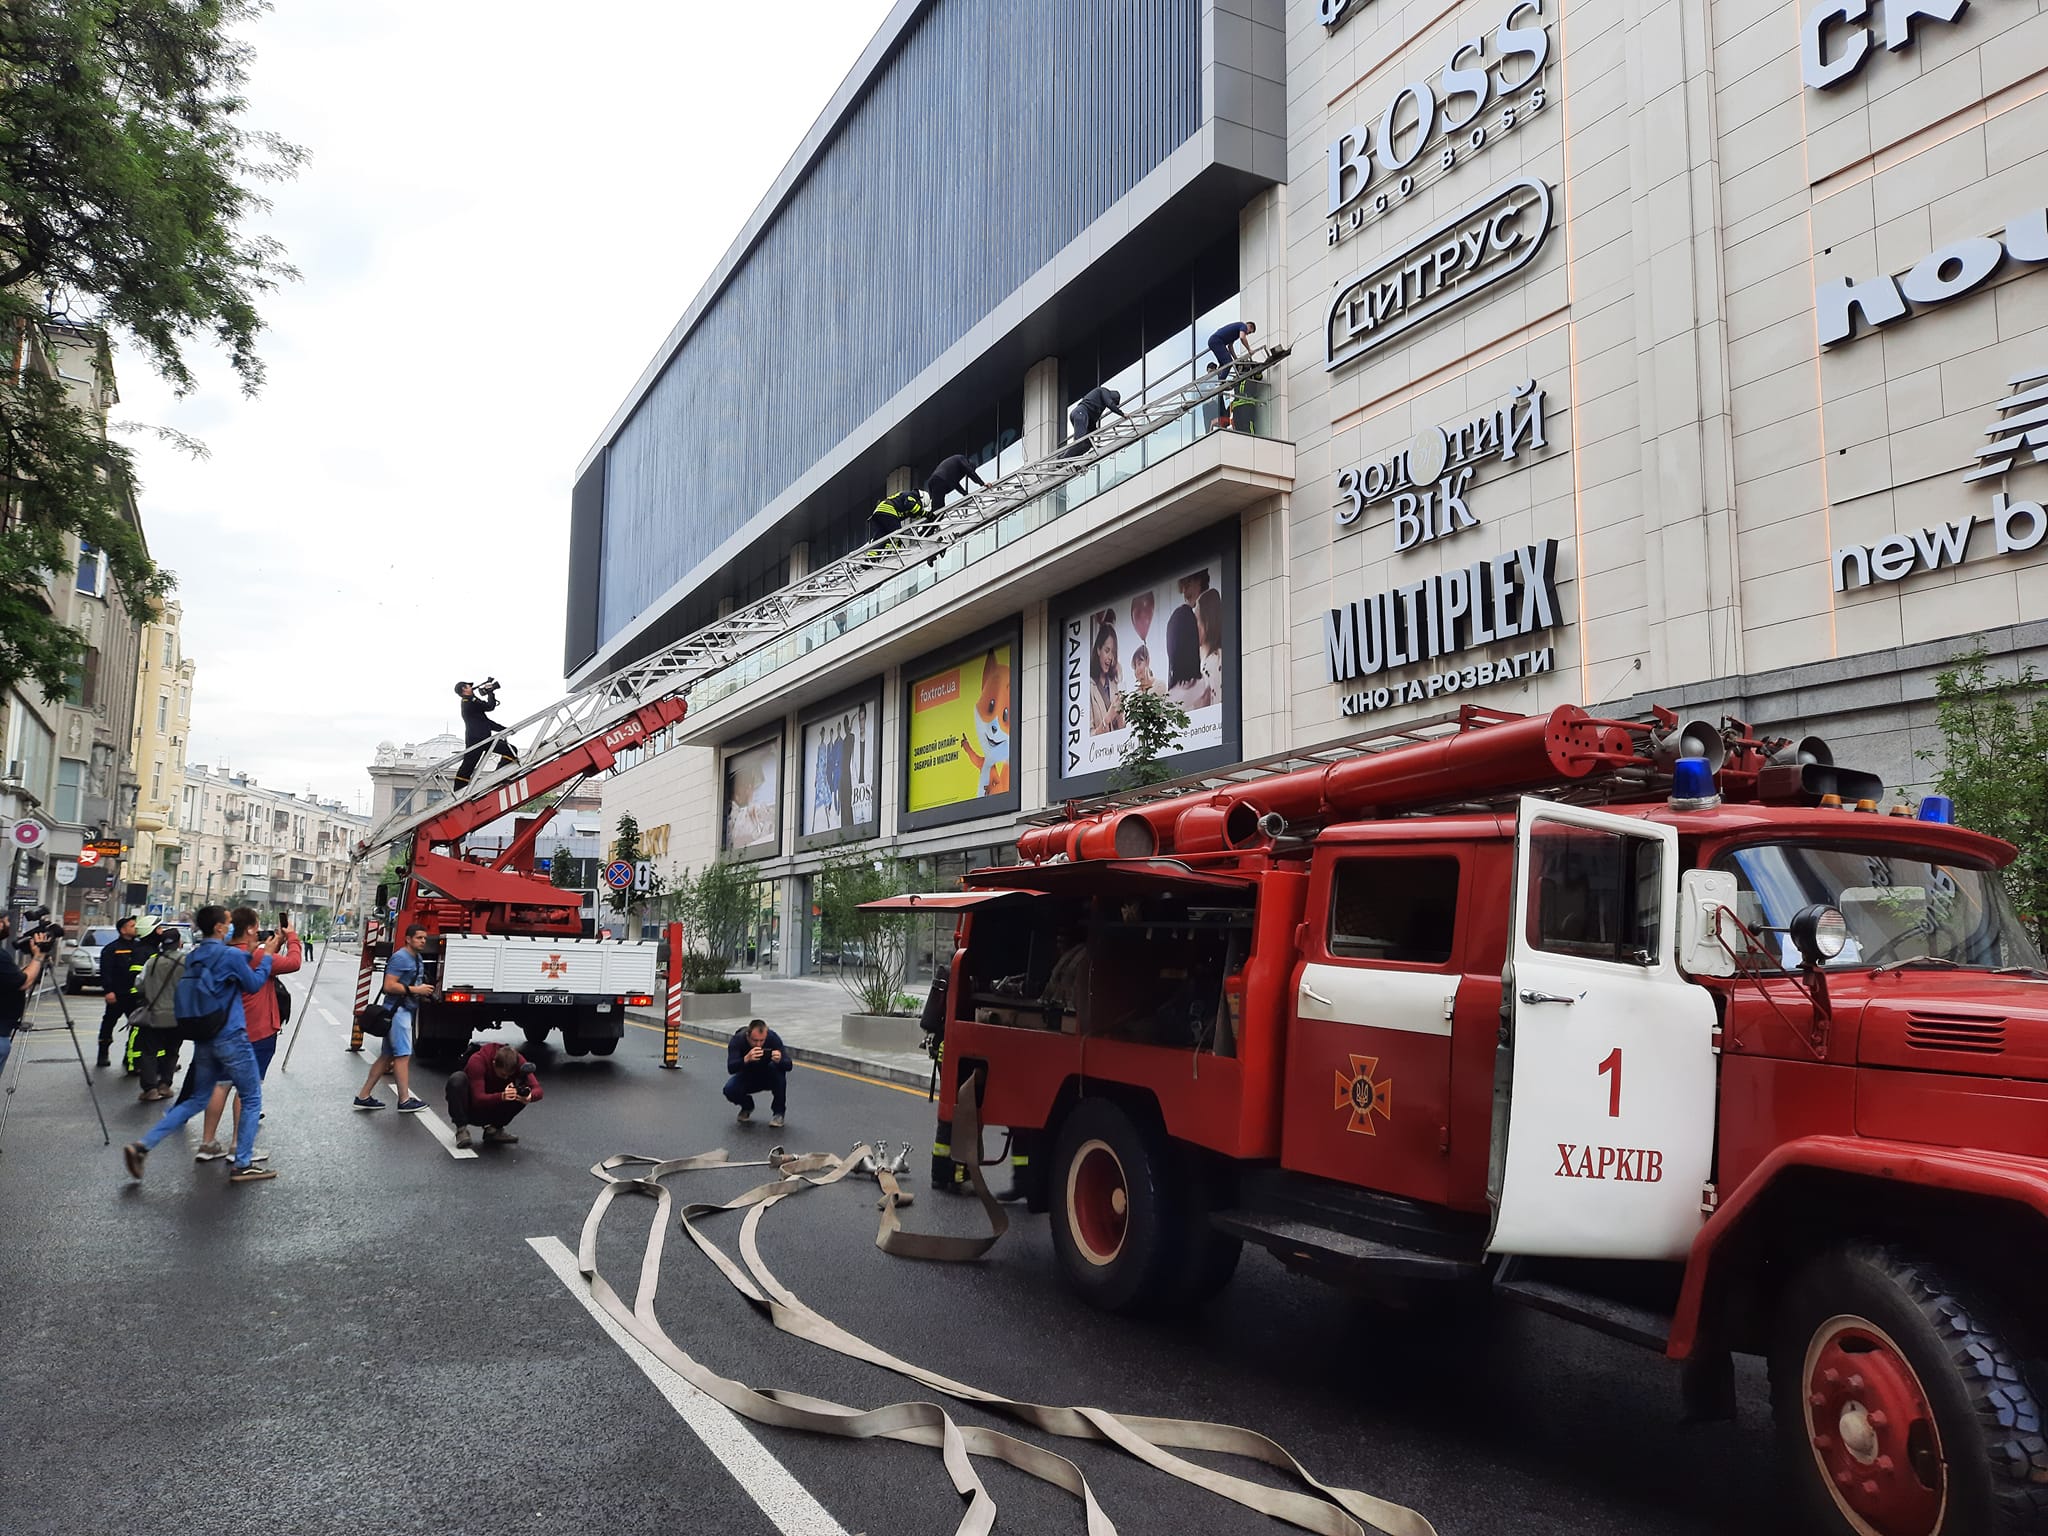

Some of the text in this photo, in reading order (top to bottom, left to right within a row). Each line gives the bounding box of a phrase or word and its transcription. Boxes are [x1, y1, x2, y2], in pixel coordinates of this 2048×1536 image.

[1326, 0, 1550, 219] BOSS
[1327, 87, 1546, 246] HUGO BOSS
[1345, 205, 1523, 337] ЦИТРУС
[1832, 515, 1977, 593] new
[1322, 538, 1565, 684] MULTIPLEX
[919, 680, 957, 704] foxtrot.ua
[1068, 620, 1082, 772] PANDORA
[1339, 647, 1555, 717] КІНО ТА РОЗВАГИ
[605, 721, 642, 748] АЛ-30
[852, 785, 873, 806] BOS
[1598, 1047, 1622, 1118] 1
[1554, 1143, 1663, 1183] ХАРКІВ
